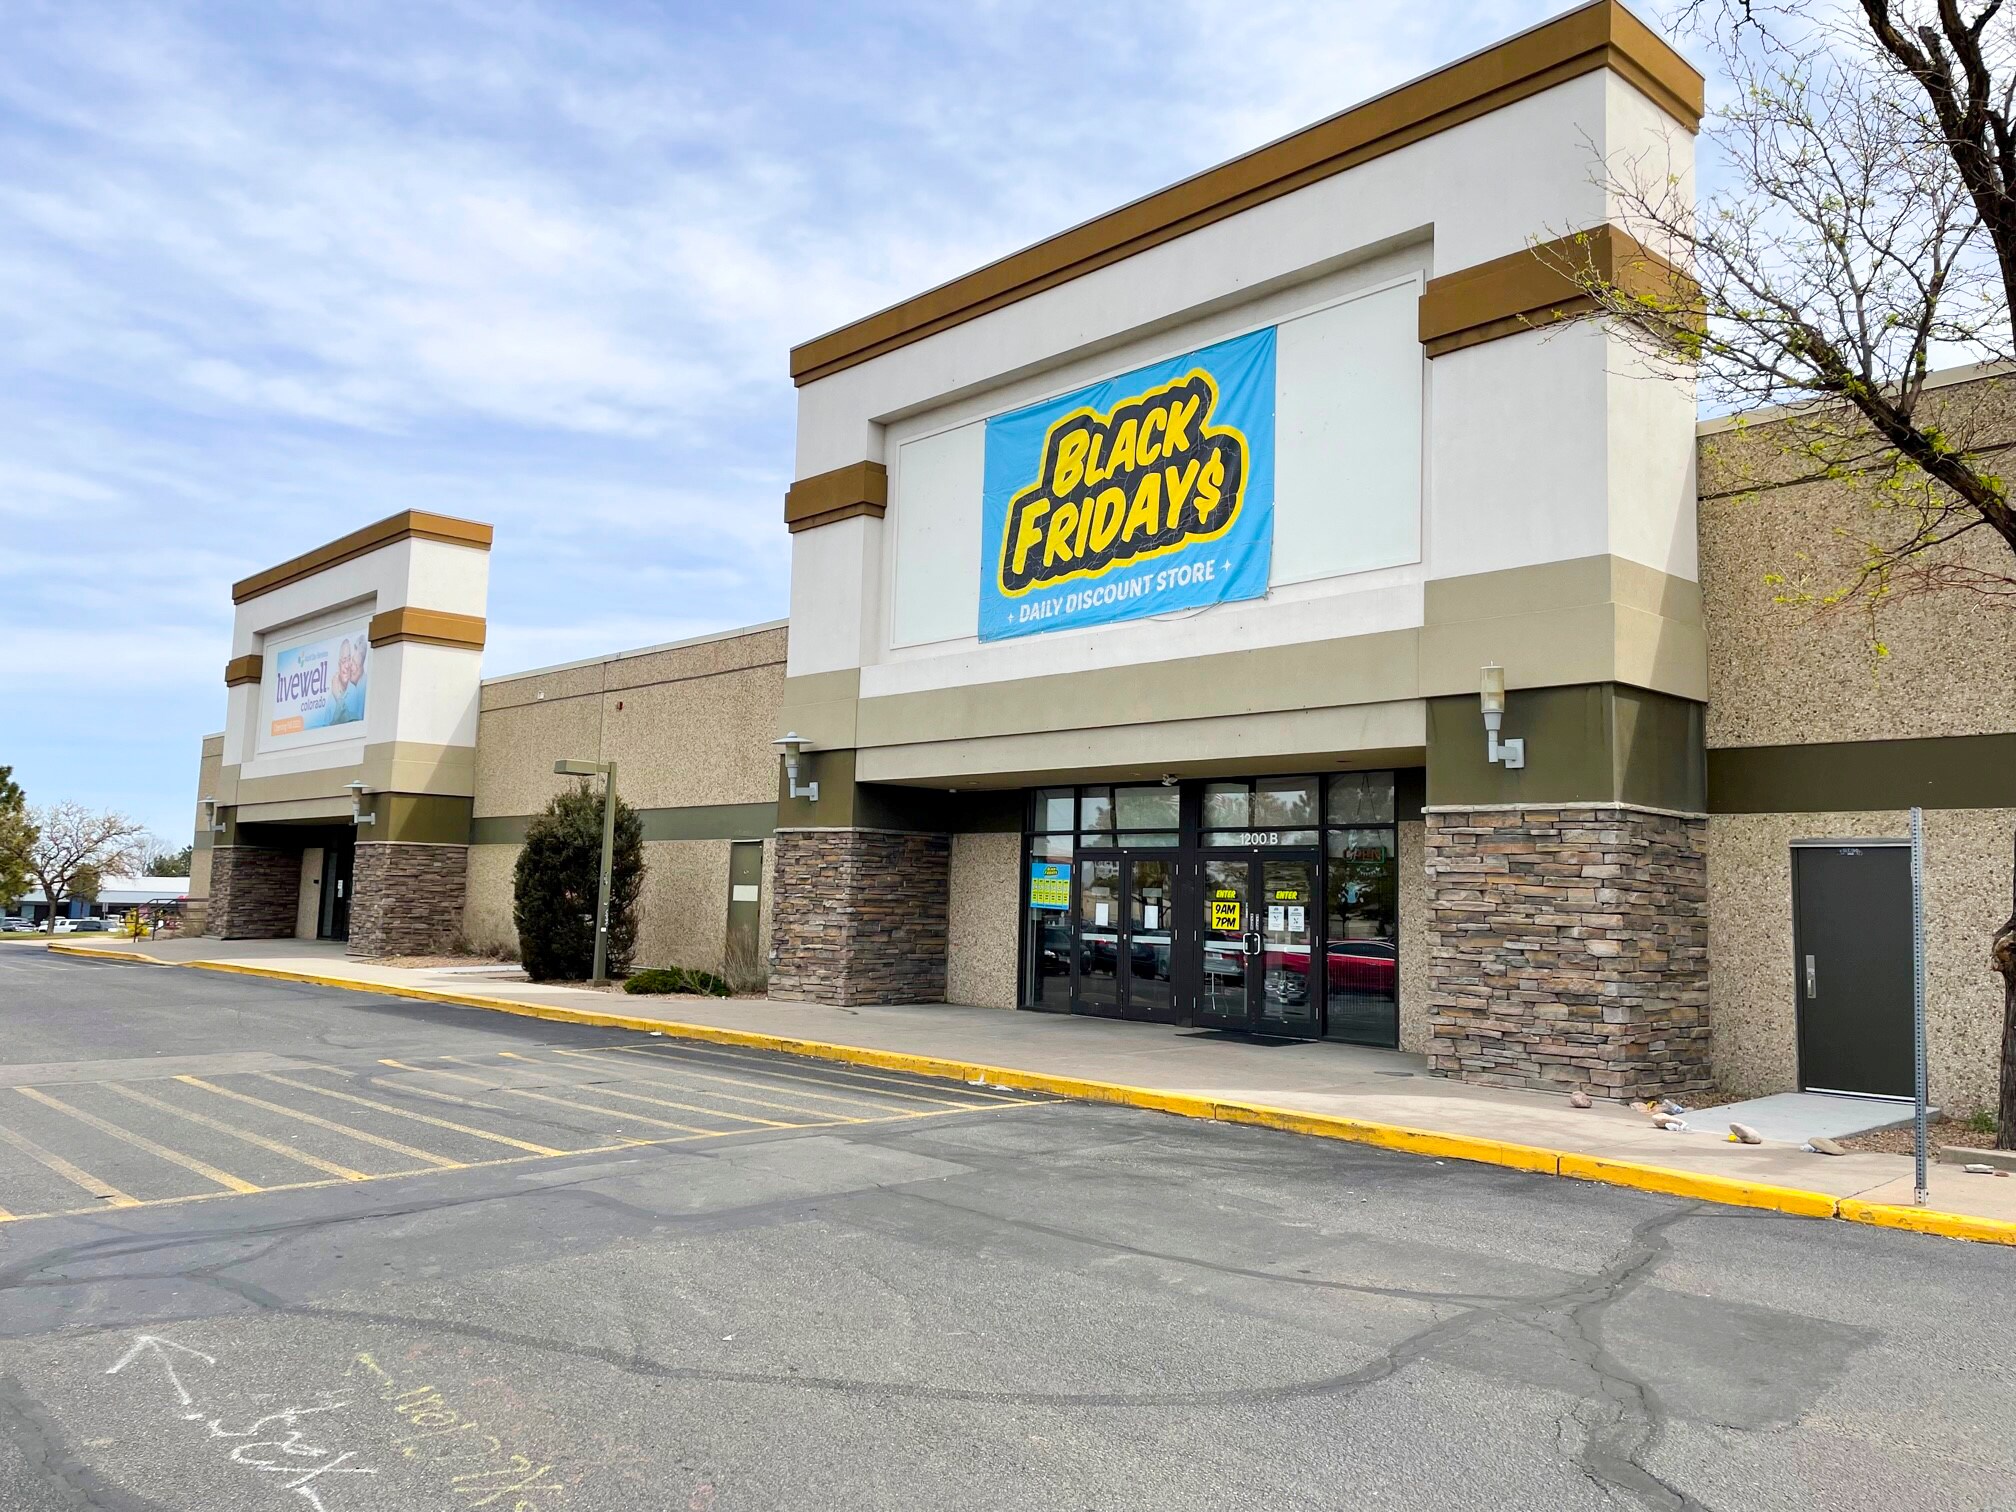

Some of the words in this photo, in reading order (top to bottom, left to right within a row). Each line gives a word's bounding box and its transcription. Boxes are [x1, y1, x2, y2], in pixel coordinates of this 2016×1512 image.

[1052, 394, 1200, 497] BLACK
[1012, 447, 1225, 575] FRIDAY$
[1019, 598, 1063, 623] DAILY
[1065, 576, 1153, 614] DISCOUNT
[1156, 559, 1216, 592] STORE
[276, 660, 328, 703] livewell
[300, 696, 326, 712] colorado
[1240, 832, 1267, 845] 1200
[1270, 832, 1279, 845] B
[1215, 889, 1237, 899] ENTER
[1275, 890, 1298, 900] ENTER
[1215, 904, 1236, 915] 9AM
[1215, 917, 1236, 928] 7PM
